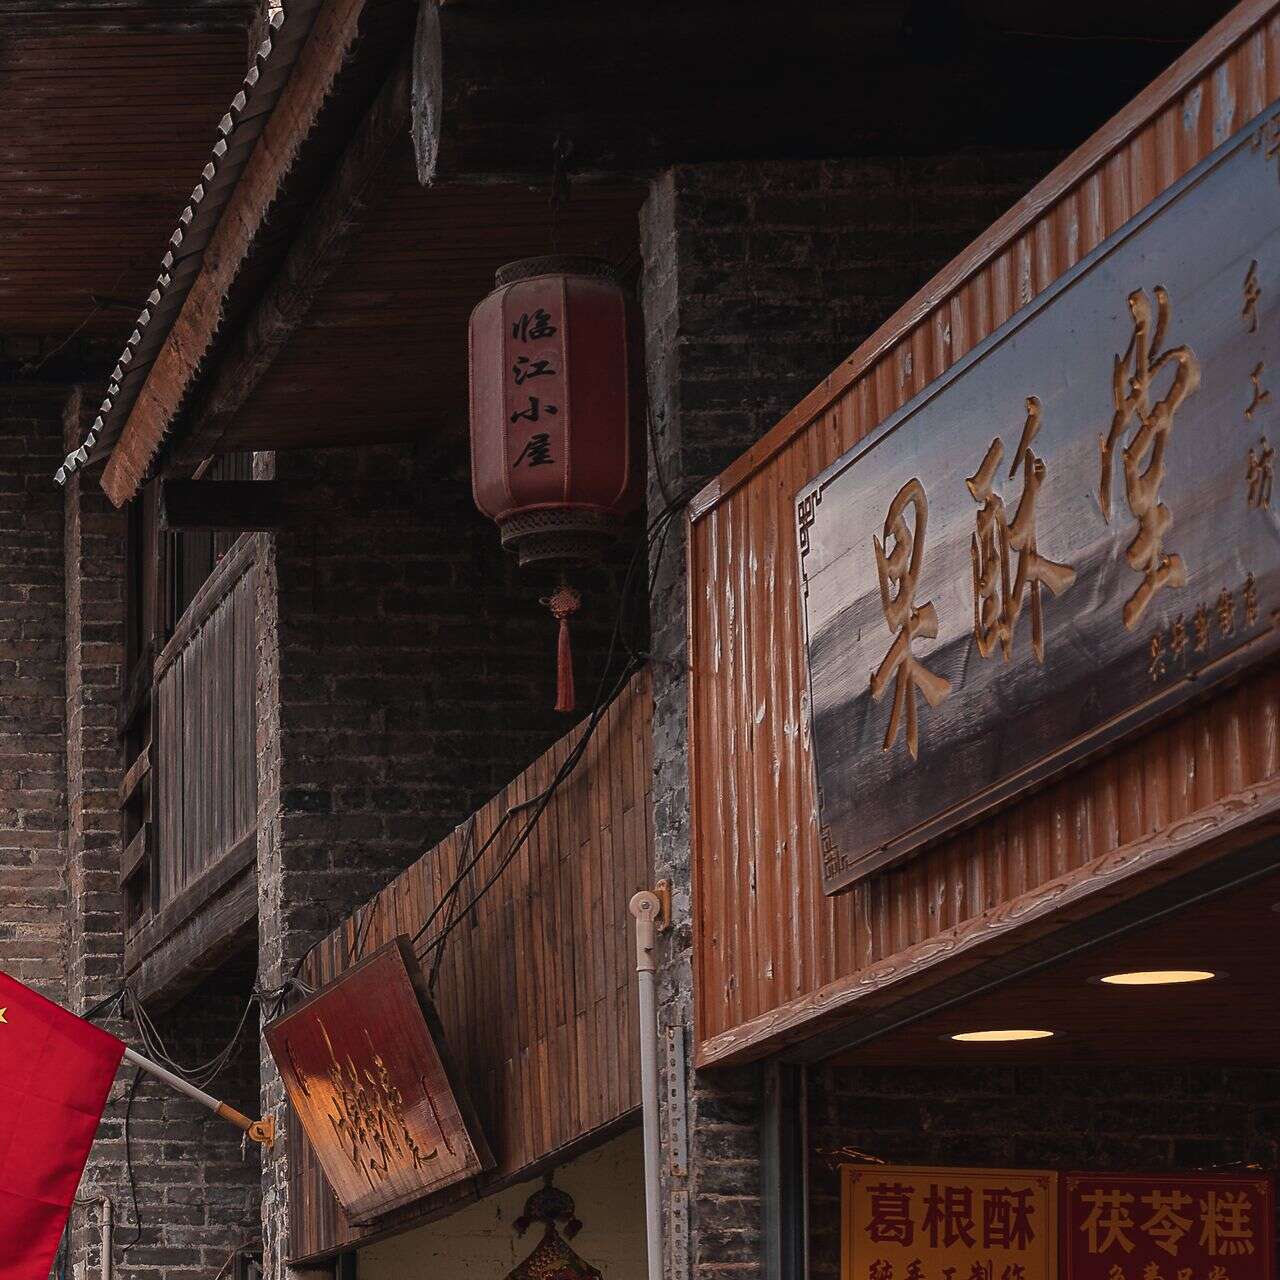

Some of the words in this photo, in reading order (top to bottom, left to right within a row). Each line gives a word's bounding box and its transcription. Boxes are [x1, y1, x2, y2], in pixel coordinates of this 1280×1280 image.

[511, 308, 558, 468] 临江小屋
[865, 1182, 1036, 1251] 葛根酥
[1080, 1188, 1255, 1257] 茯苓糕
